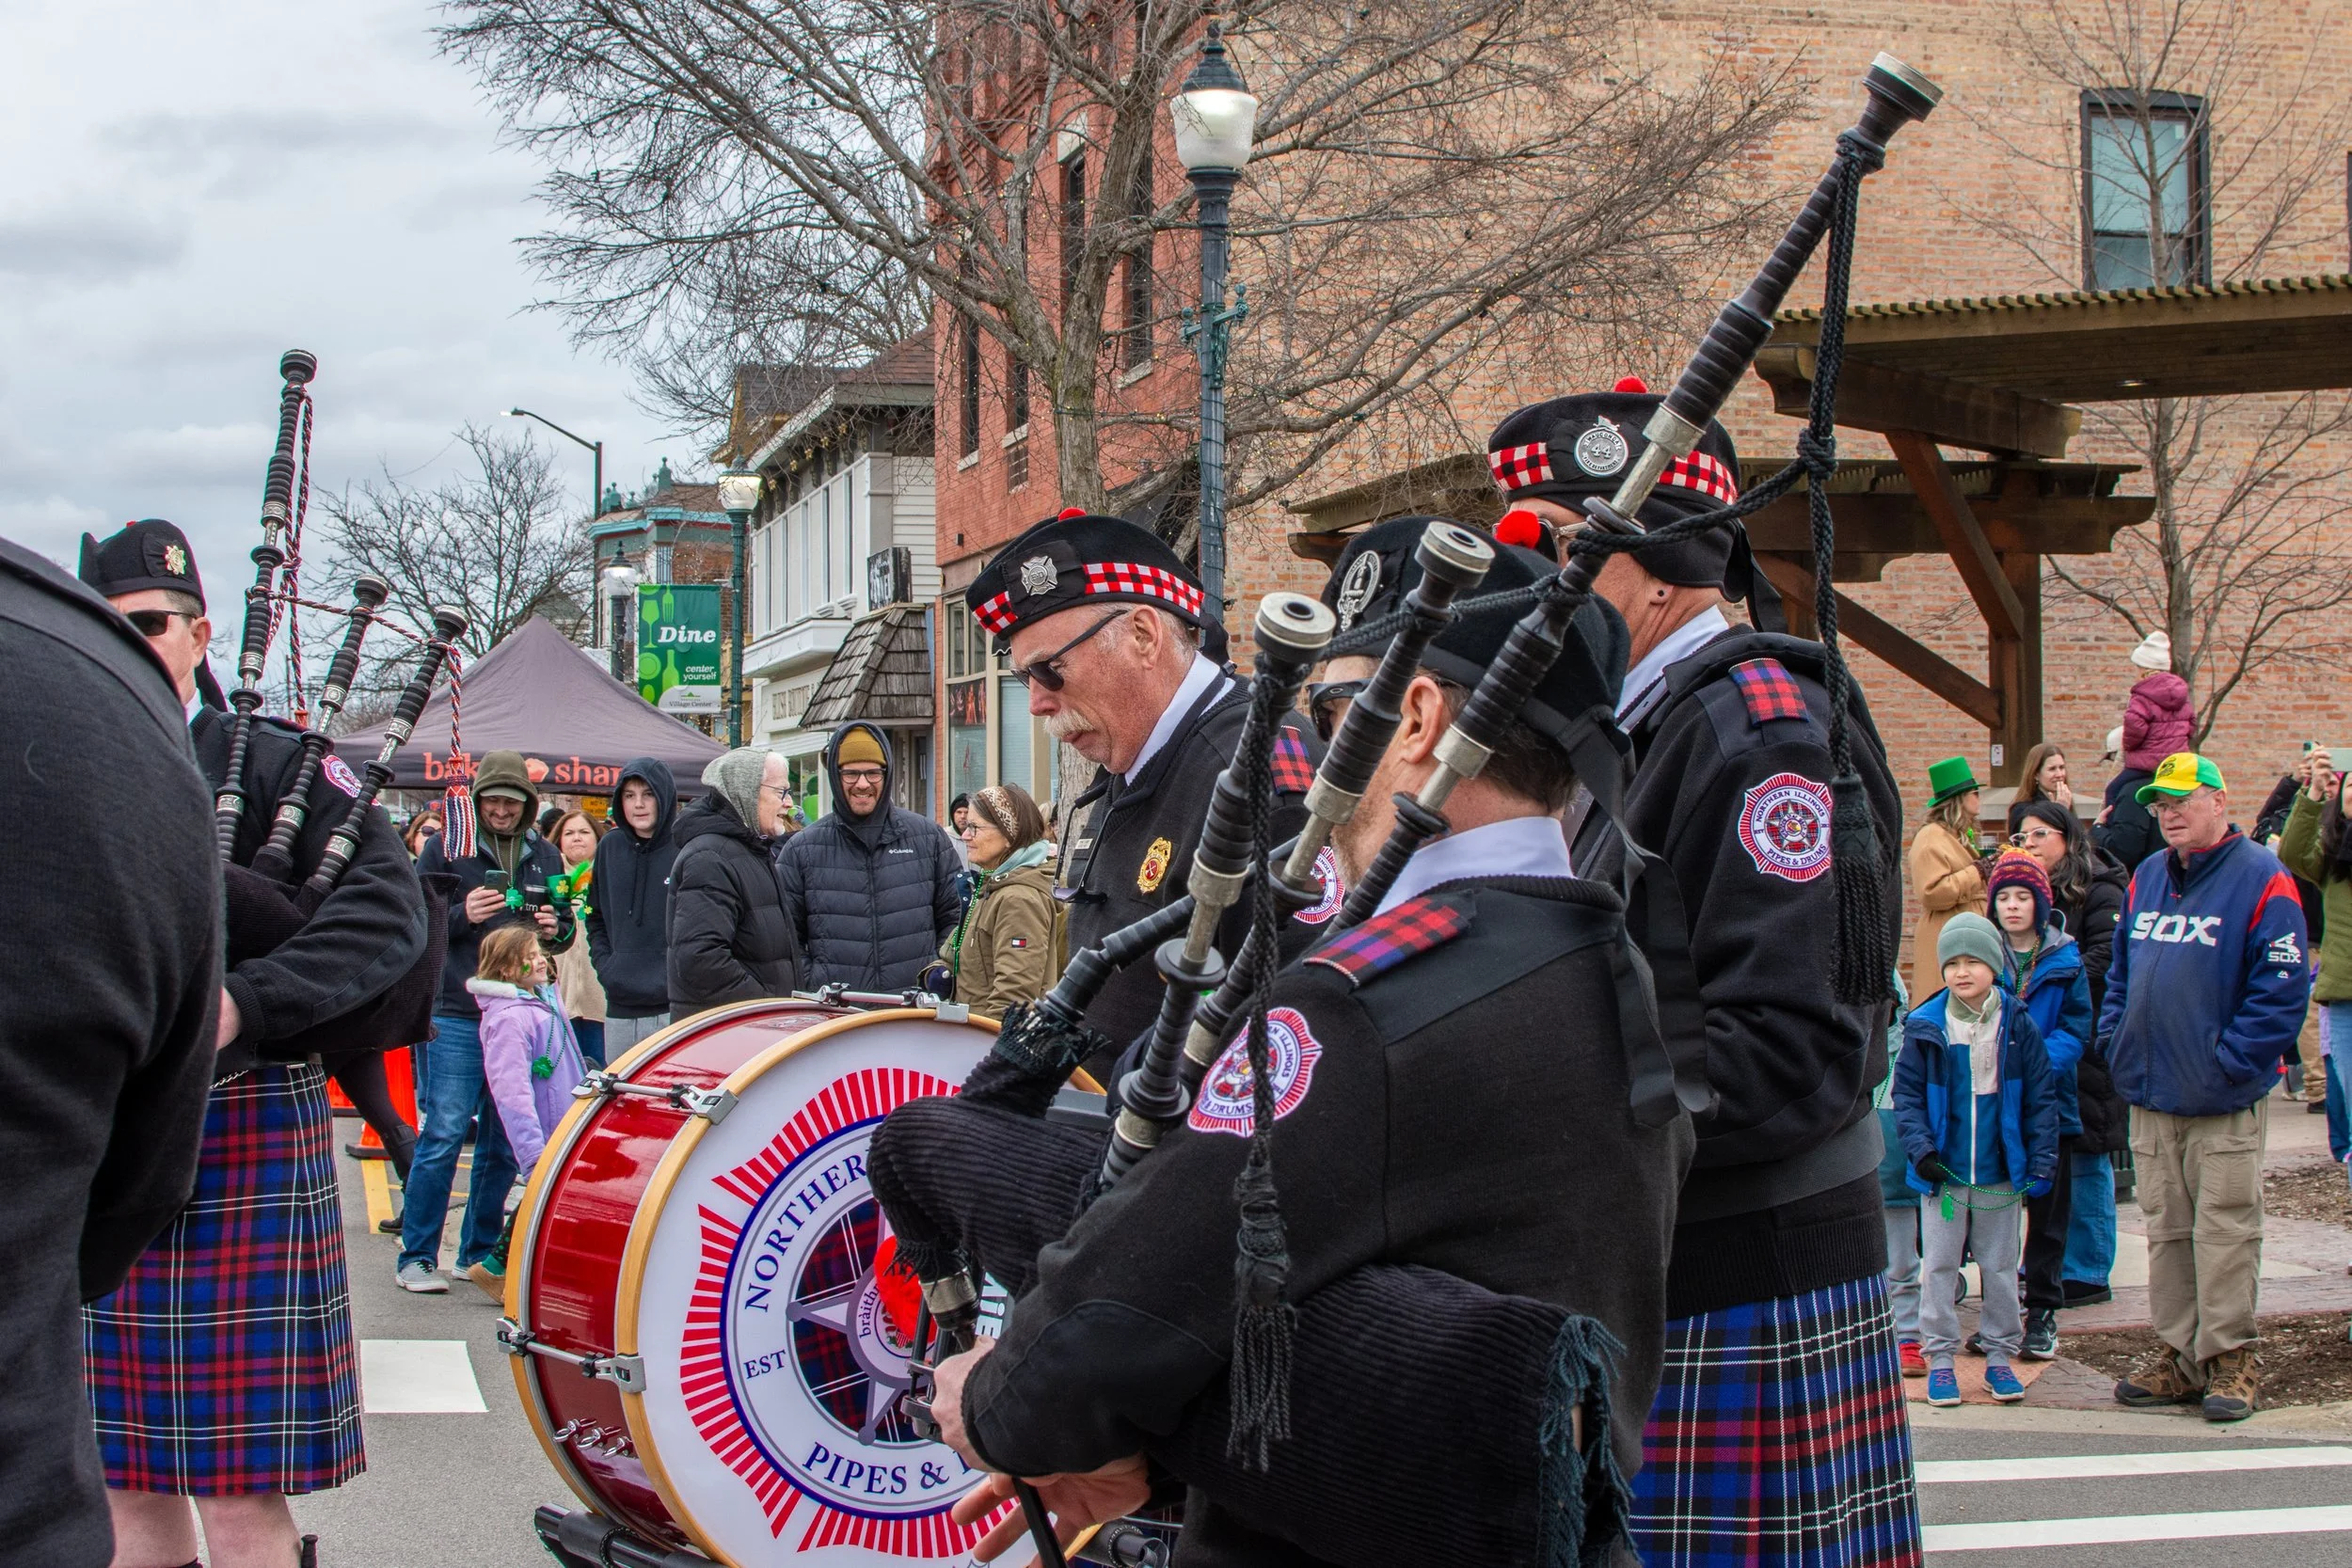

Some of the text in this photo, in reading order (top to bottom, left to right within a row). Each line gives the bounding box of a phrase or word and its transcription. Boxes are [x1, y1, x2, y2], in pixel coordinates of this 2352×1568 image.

[1586, 432, 1622, 447] WAUCONDA
[1591, 444, 1612, 459] 44
[658, 625, 716, 643] Dine
[683, 672, 717, 682] yourself
[555, 755, 623, 786] shar
[1756, 791, 1825, 822] NORTHERN ILLINOIS
[1767, 848, 1790, 864] PIPES
[1801, 844, 1826, 864] DRUMS
[2130, 911, 2221, 946] SOX
[2267, 952, 2301, 963] SOX
[1279, 1033, 1294, 1078] ILLINOIS
[1210, 1102, 1253, 1115] DRUMS
[745, 1149, 869, 1313] NORTHER
[743, 1350, 786, 1379] EST
[802, 1441, 907, 1495] PIPES
[920, 1461, 950, 1489] &
